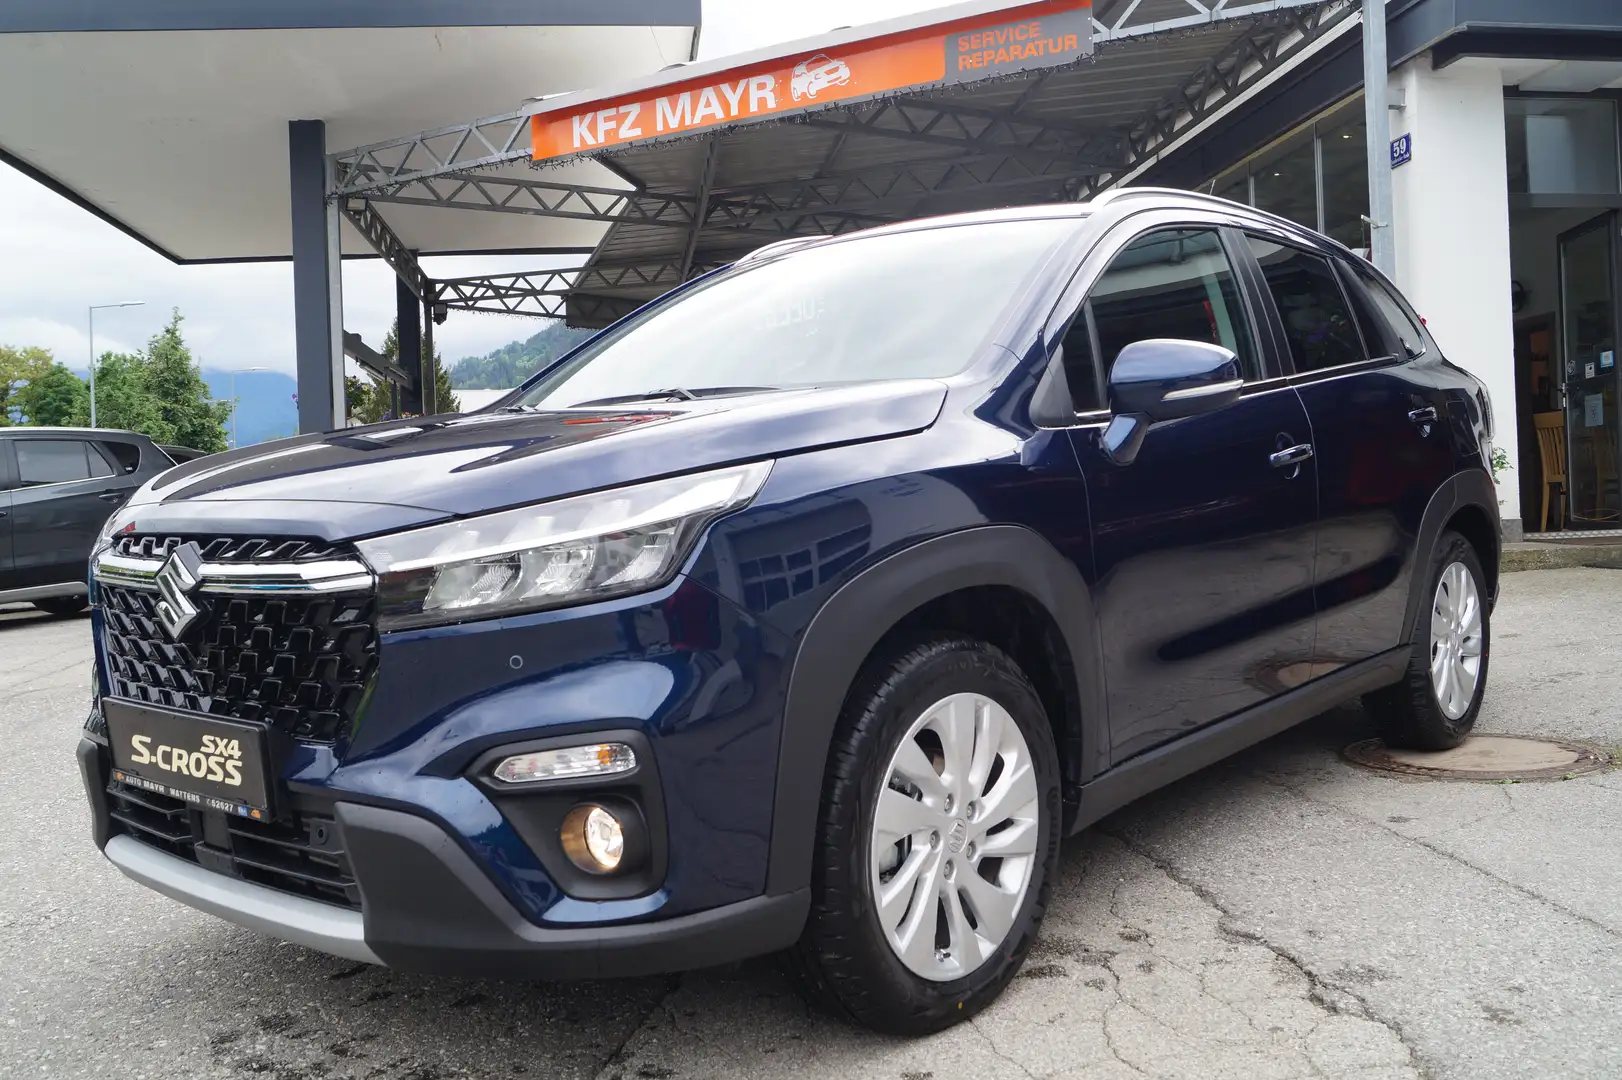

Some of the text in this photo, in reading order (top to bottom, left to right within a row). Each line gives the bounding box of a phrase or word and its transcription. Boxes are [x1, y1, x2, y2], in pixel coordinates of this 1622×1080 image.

[957, 21, 1041, 52] SERVICE
[958, 33, 1078, 72] REPARATUR
[572, 74, 777, 148] KFZ MAYR
[1393, 138, 1407, 158] 59
[200, 734, 242, 760] SX4
[126, 775, 142, 787] AUTO
[143, 780, 165, 794] MAYR
[169, 787, 201, 804] WATTENS
